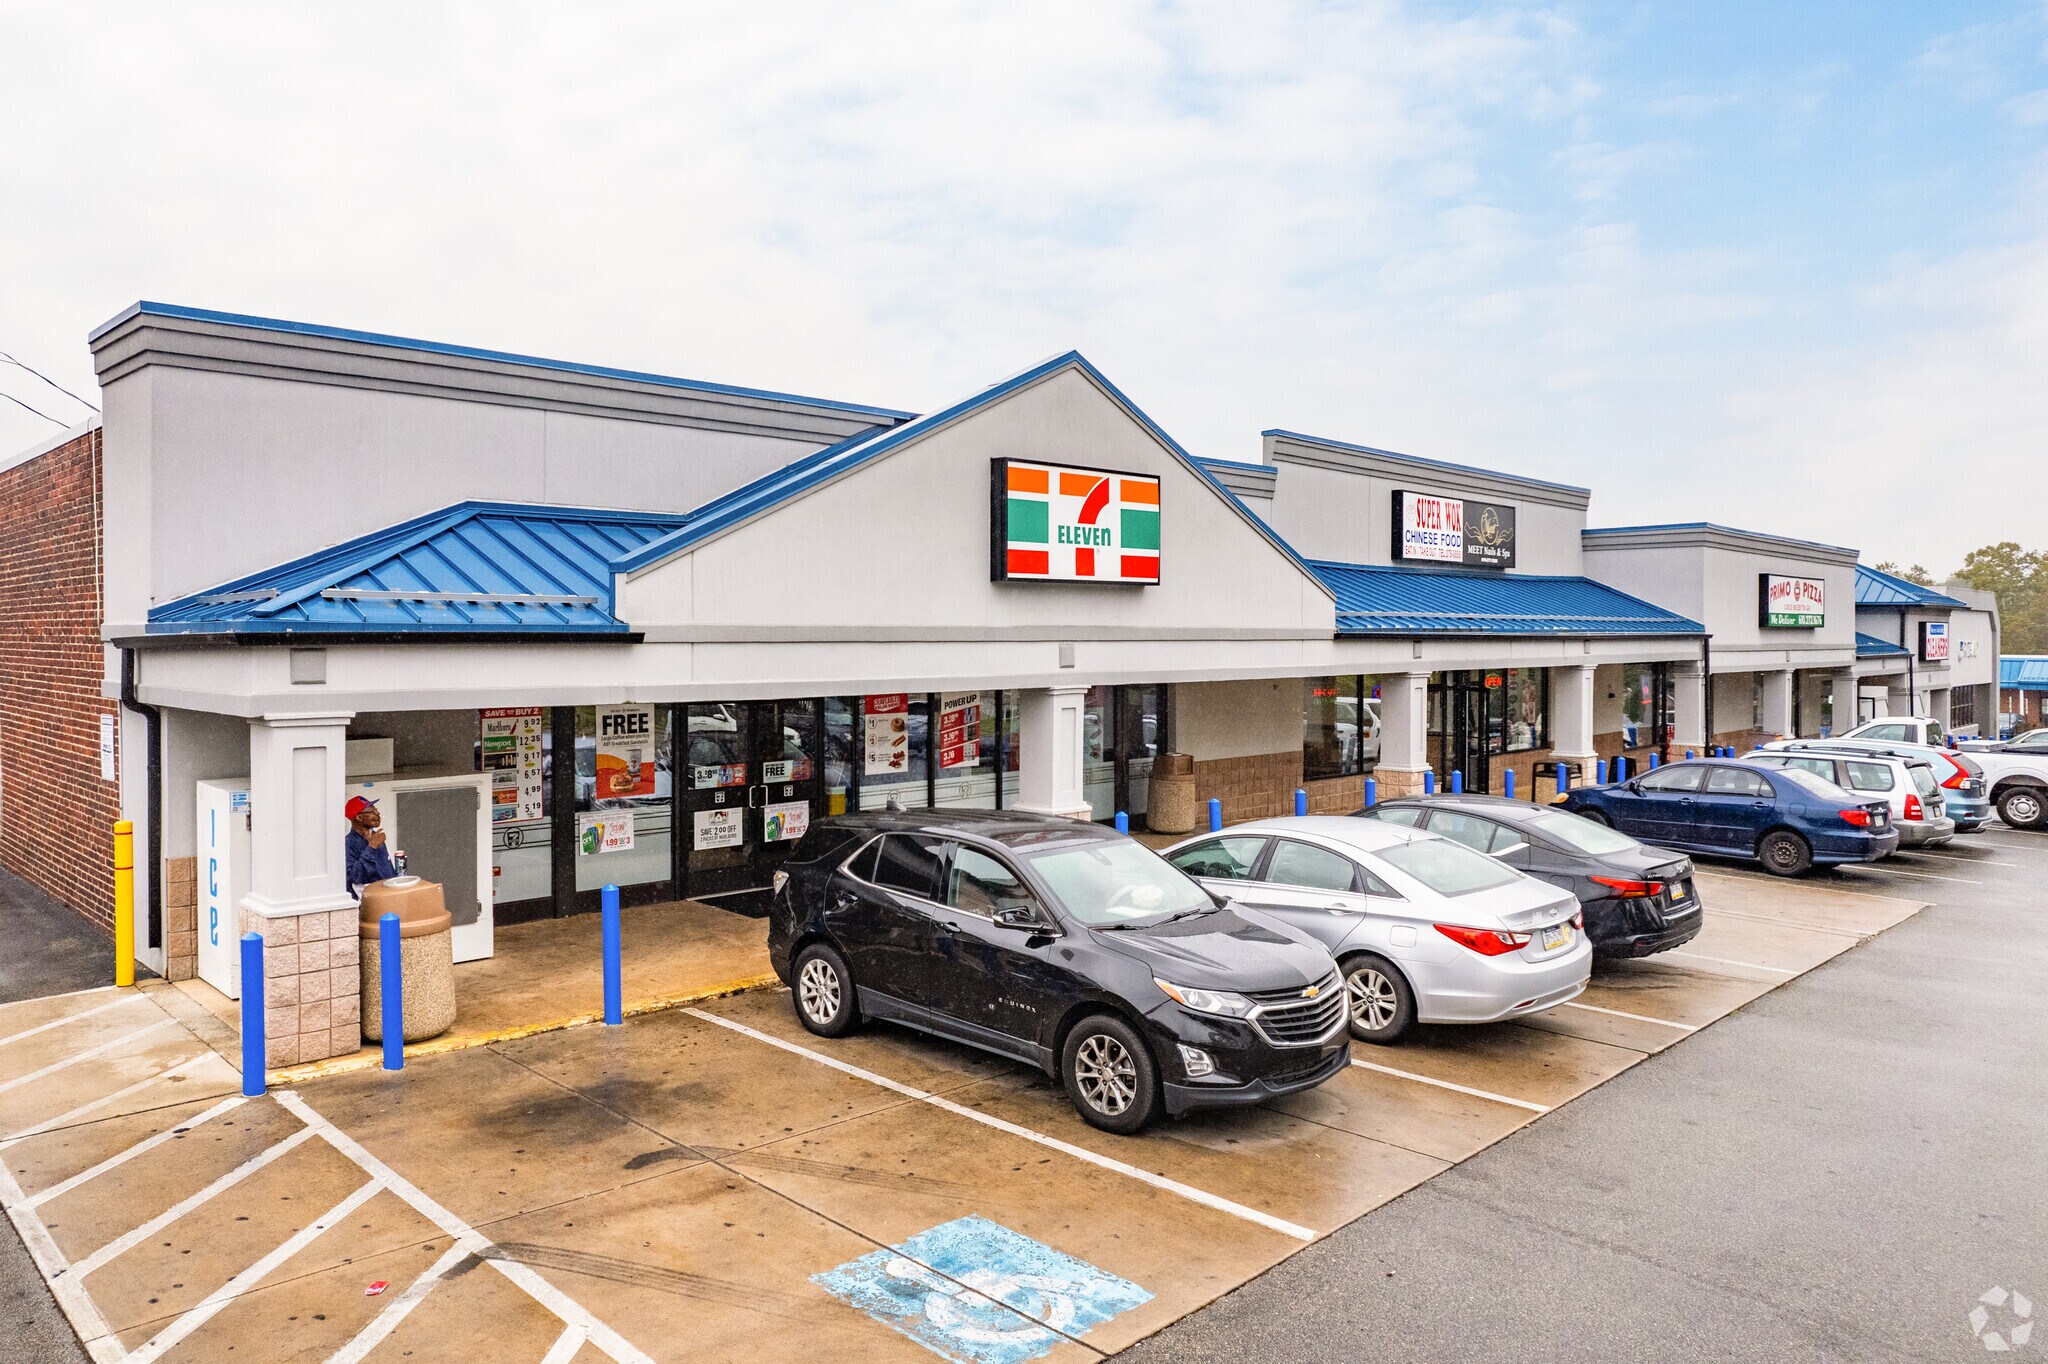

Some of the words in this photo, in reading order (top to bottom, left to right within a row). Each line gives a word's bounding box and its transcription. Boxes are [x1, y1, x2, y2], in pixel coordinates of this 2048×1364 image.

[1417, 498, 1441, 530] SUPER
[1405, 529, 1438, 546] CHINESE
[1441, 533, 1461, 547] FOOD
[1770, 581, 1791, 603] PRIMO
[1803, 582, 1823, 606] PIZZA
[944, 700, 966, 710] POWER
[966, 694, 977, 704] UP
[602, 713, 649, 736] FREE
[484, 740, 512, 750] Newport
[765, 767, 785, 777] FREE
[700, 828, 712, 836] SAVE
[727, 824, 737, 833] OFF
